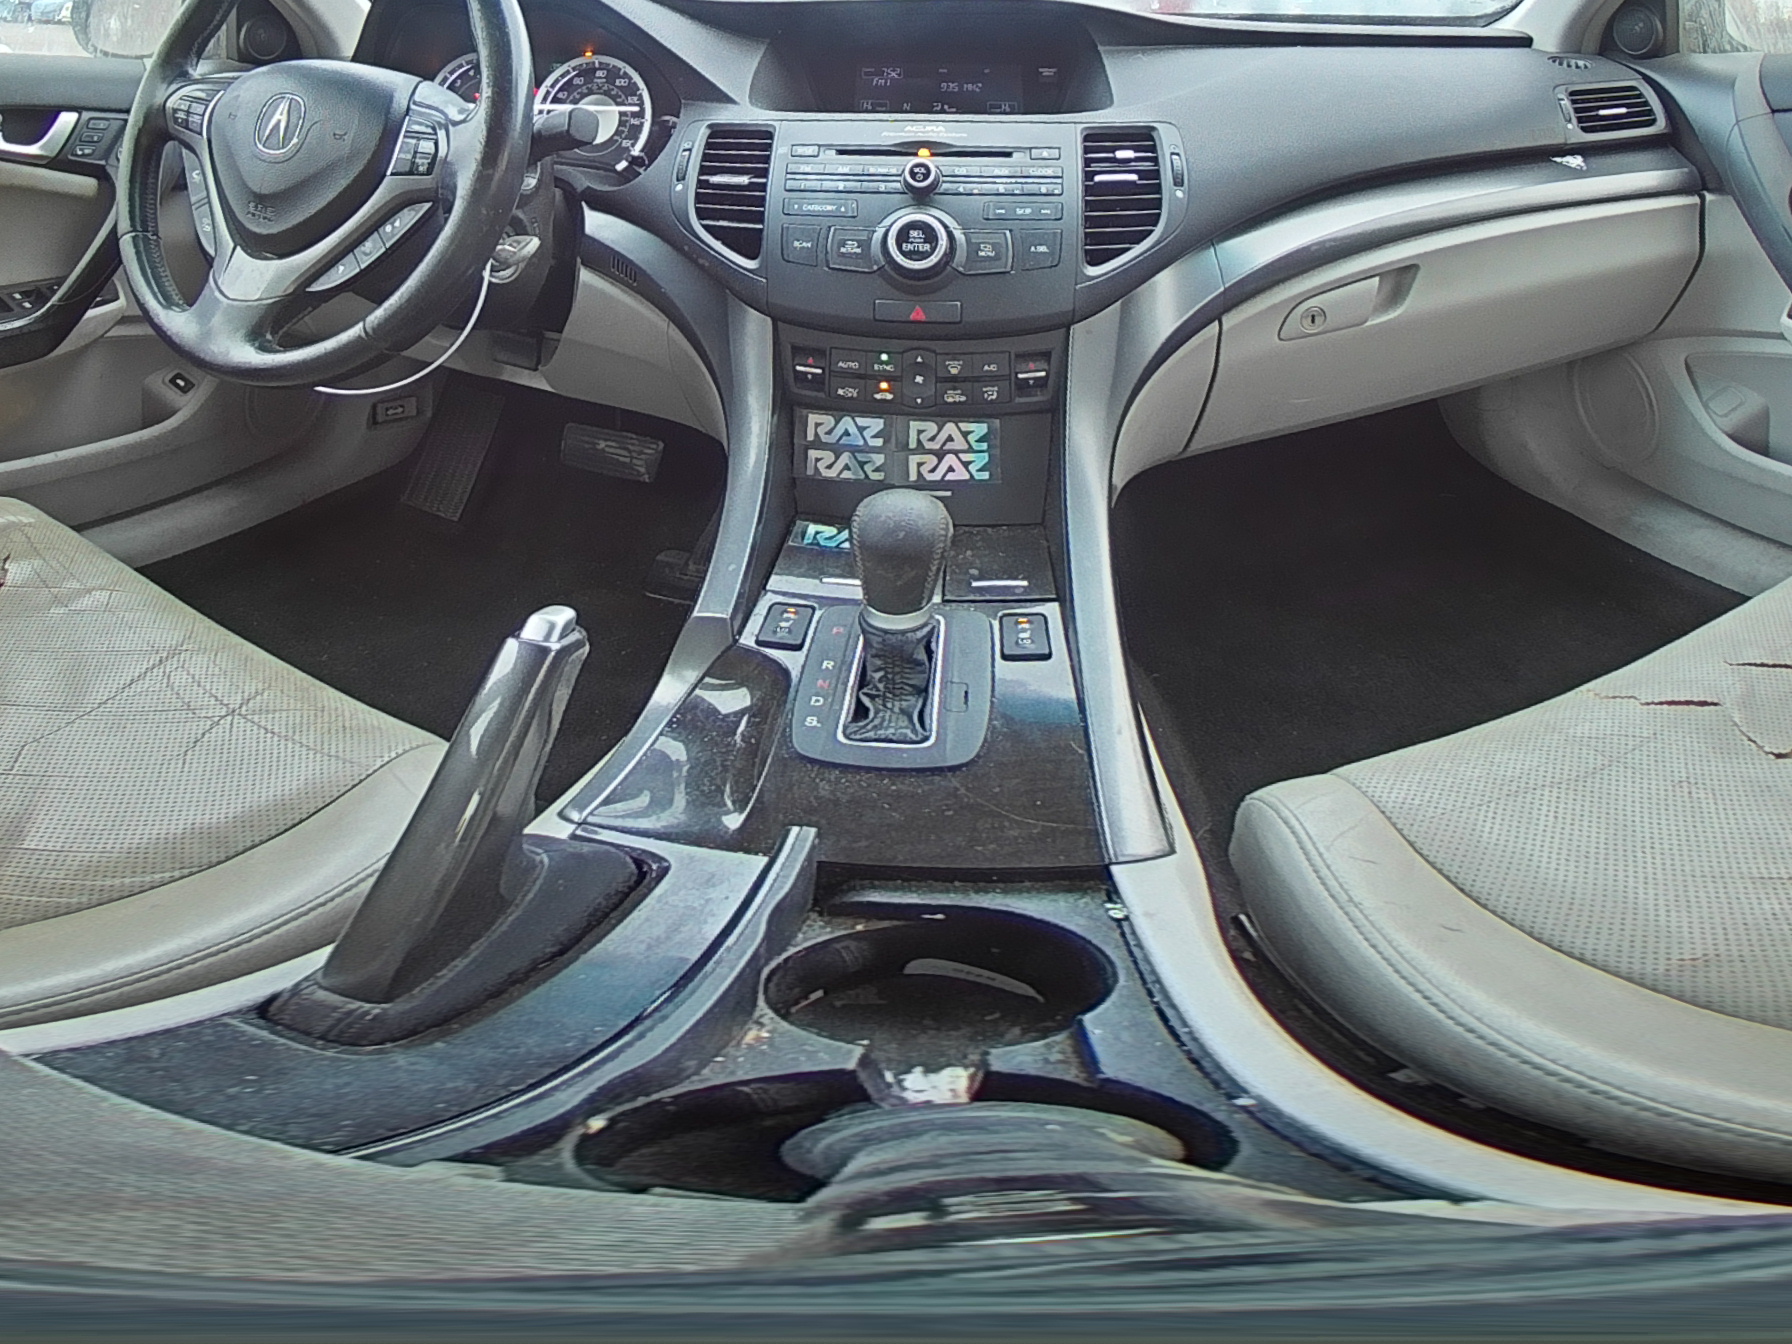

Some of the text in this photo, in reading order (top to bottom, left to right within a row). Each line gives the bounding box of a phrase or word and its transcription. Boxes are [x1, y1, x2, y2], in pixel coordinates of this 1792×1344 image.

[573, 77, 584, 85] 60
[909, 229, 925, 238] SEL
[793, 240, 812, 248] SCAN
[901, 242, 931, 252] ENTER
[838, 360, 859, 369] AUTO
[873, 363, 895, 371] SYNC
[806, 413, 988, 451] RAZ RAZ
[806, 448, 990, 482] RAZ RAZ
[832, 626, 844, 635] P
[821, 660, 835, 670] R
[816, 679, 830, 689] N
[810, 696, 824, 706] D
